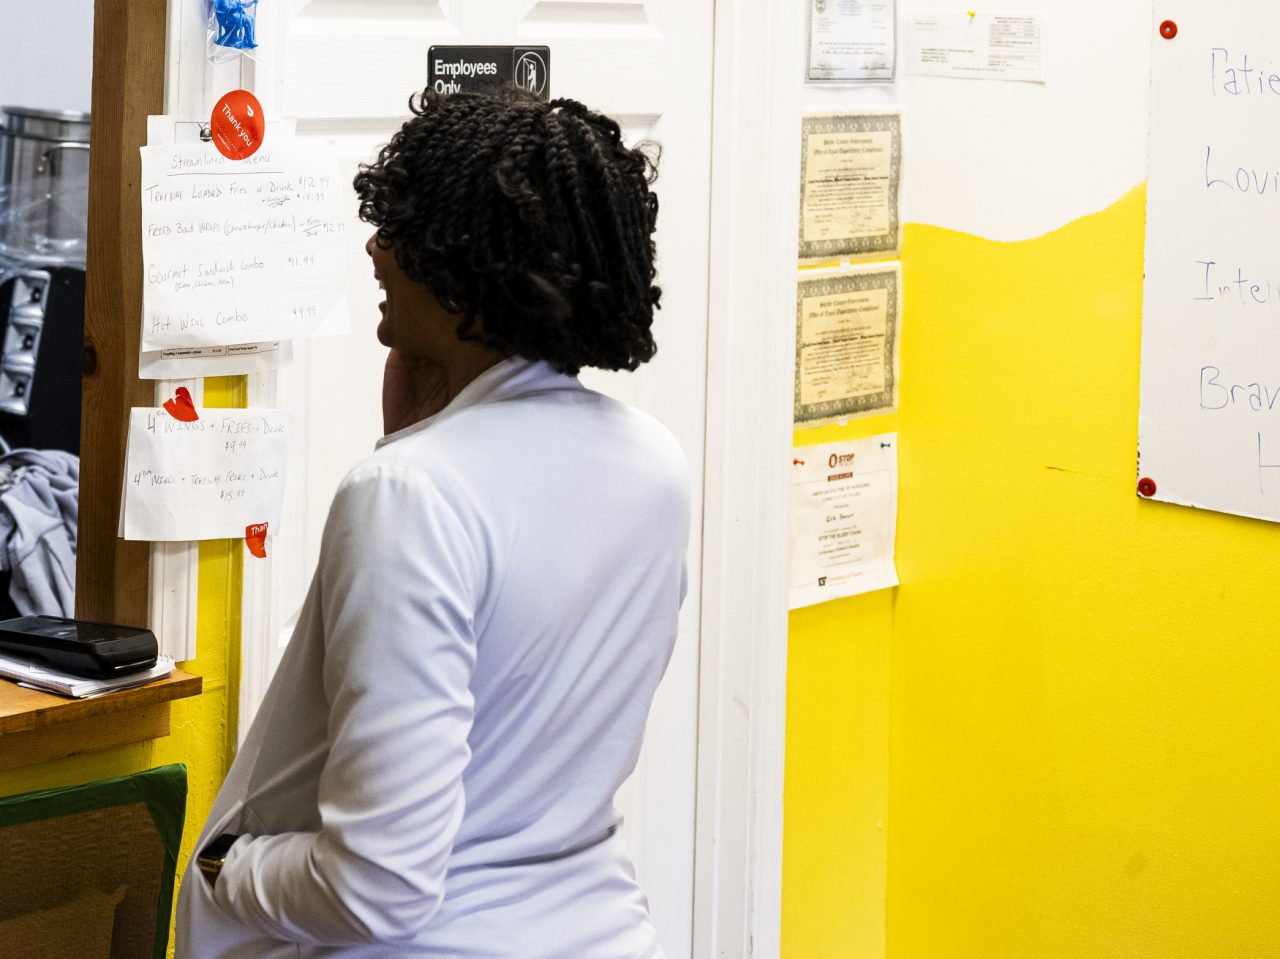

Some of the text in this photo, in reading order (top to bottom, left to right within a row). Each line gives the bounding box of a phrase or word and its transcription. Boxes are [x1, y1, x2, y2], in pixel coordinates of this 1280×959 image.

[434, 59, 498, 79] Employees
[222, 103, 242, 132] Thank
[238, 129, 253, 147] you
[216, 308, 248, 326] Combo
[147, 413, 156, 435] 4
